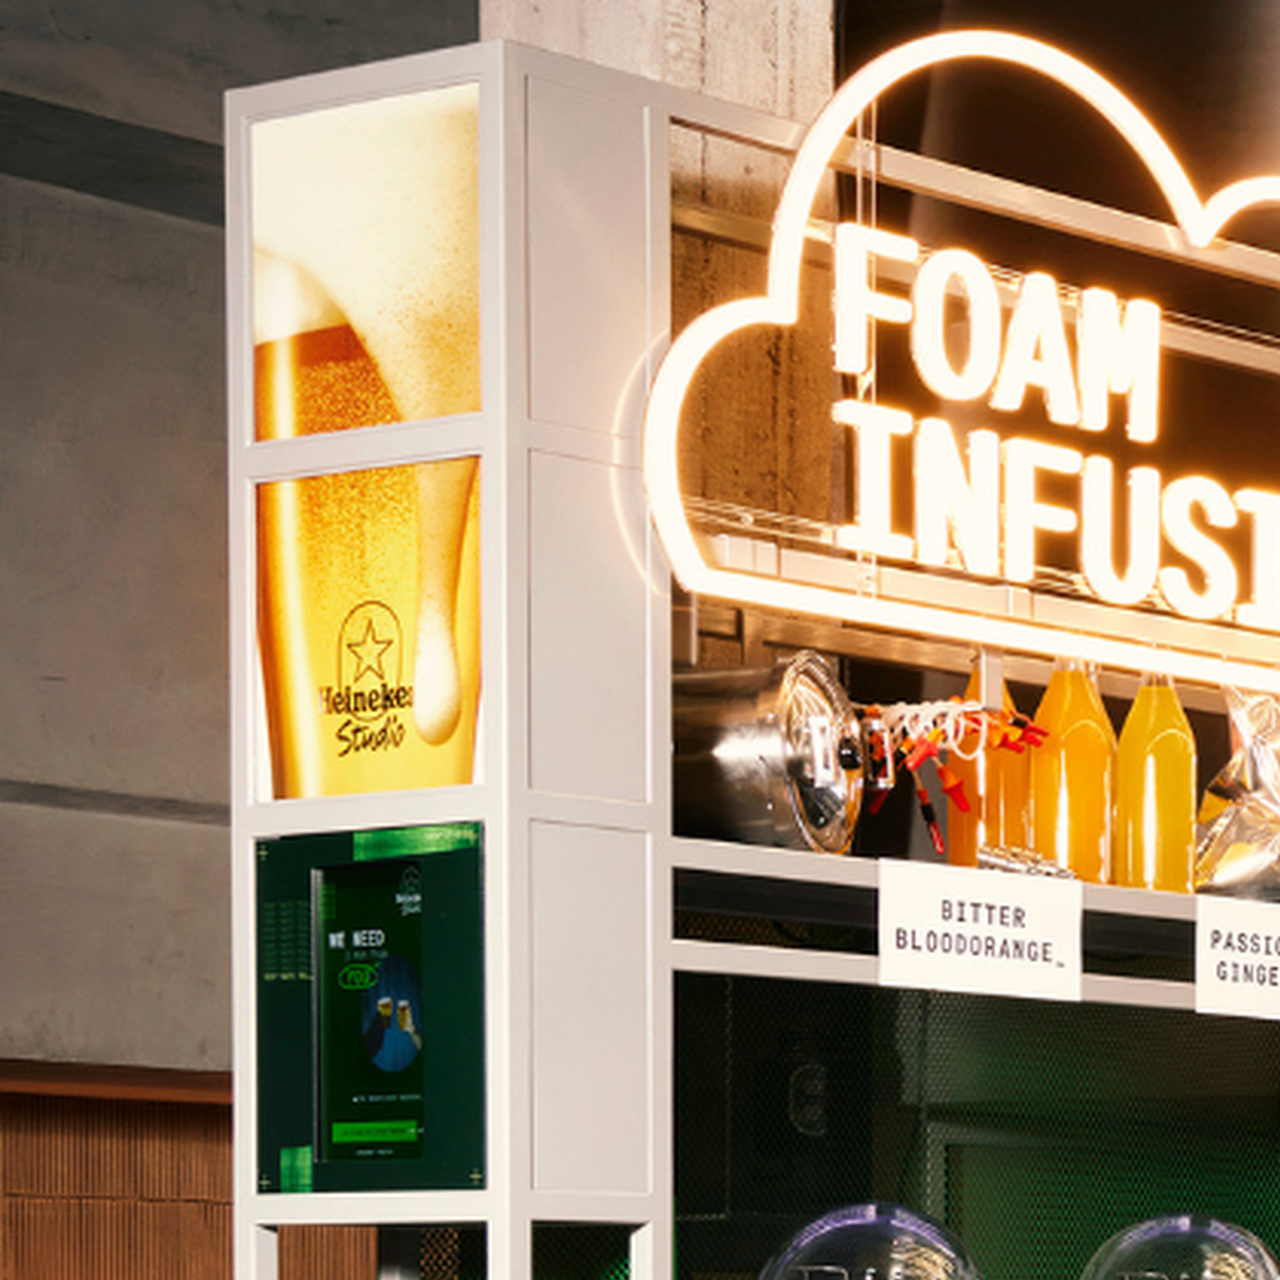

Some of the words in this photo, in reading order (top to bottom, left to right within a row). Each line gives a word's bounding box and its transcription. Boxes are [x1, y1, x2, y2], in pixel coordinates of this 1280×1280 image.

[834, 224, 1160, 442] FOAM
[335, 715, 405, 757] Studio
[941, 900, 1026, 928] BITTER
[353, 930, 385, 947] NEED
